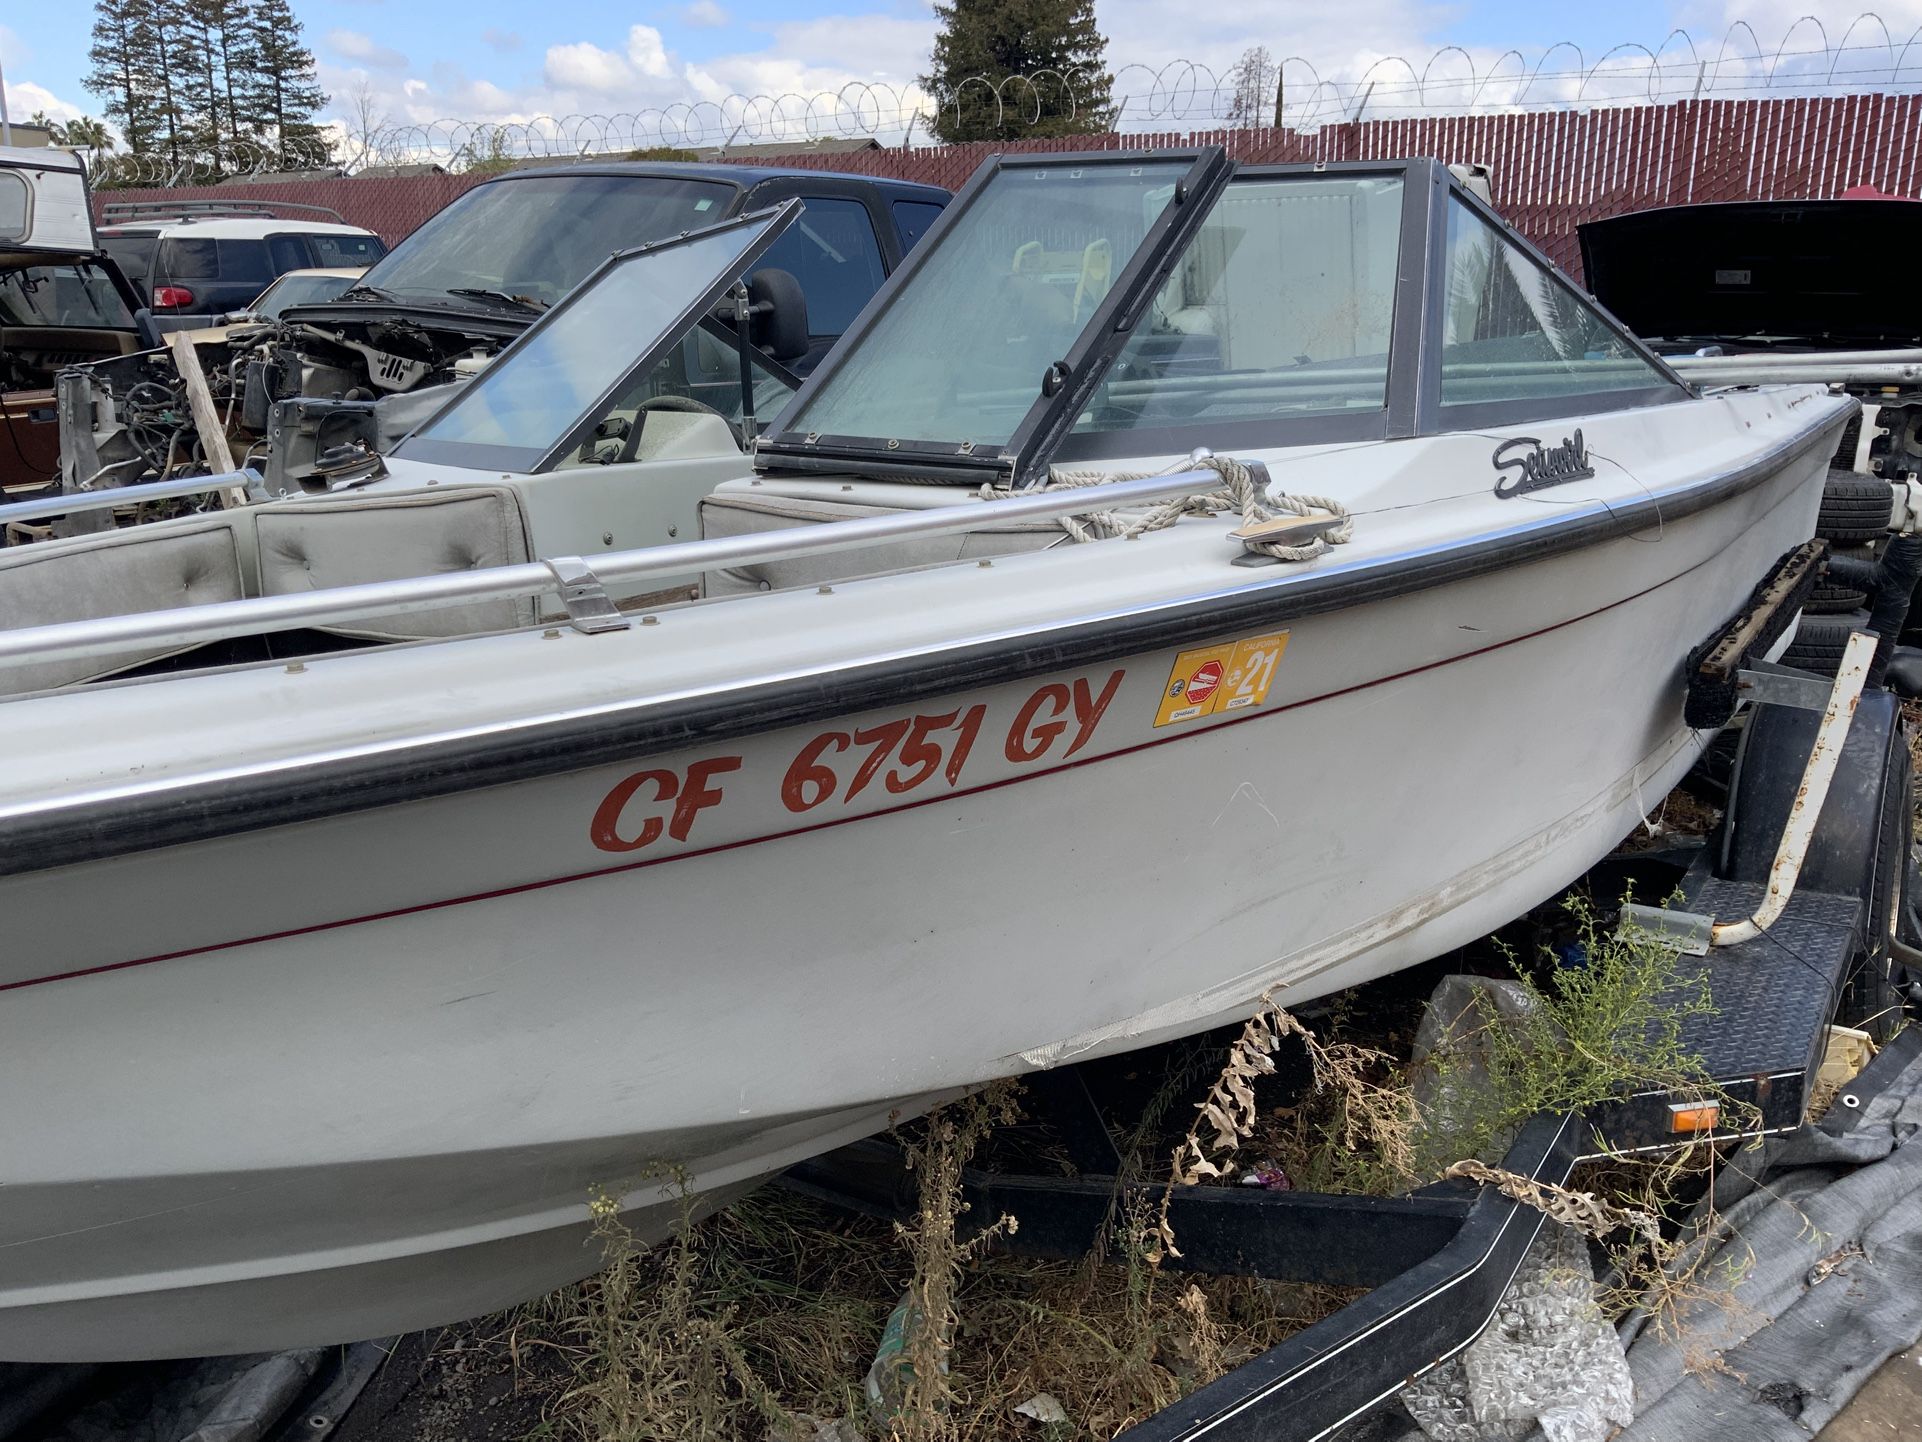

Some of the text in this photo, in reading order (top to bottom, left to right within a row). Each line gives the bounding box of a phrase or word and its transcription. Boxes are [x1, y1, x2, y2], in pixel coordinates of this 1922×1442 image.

[1235, 648, 1280, 695] 21
[590, 669, 1126, 853] CF 6751 GY
